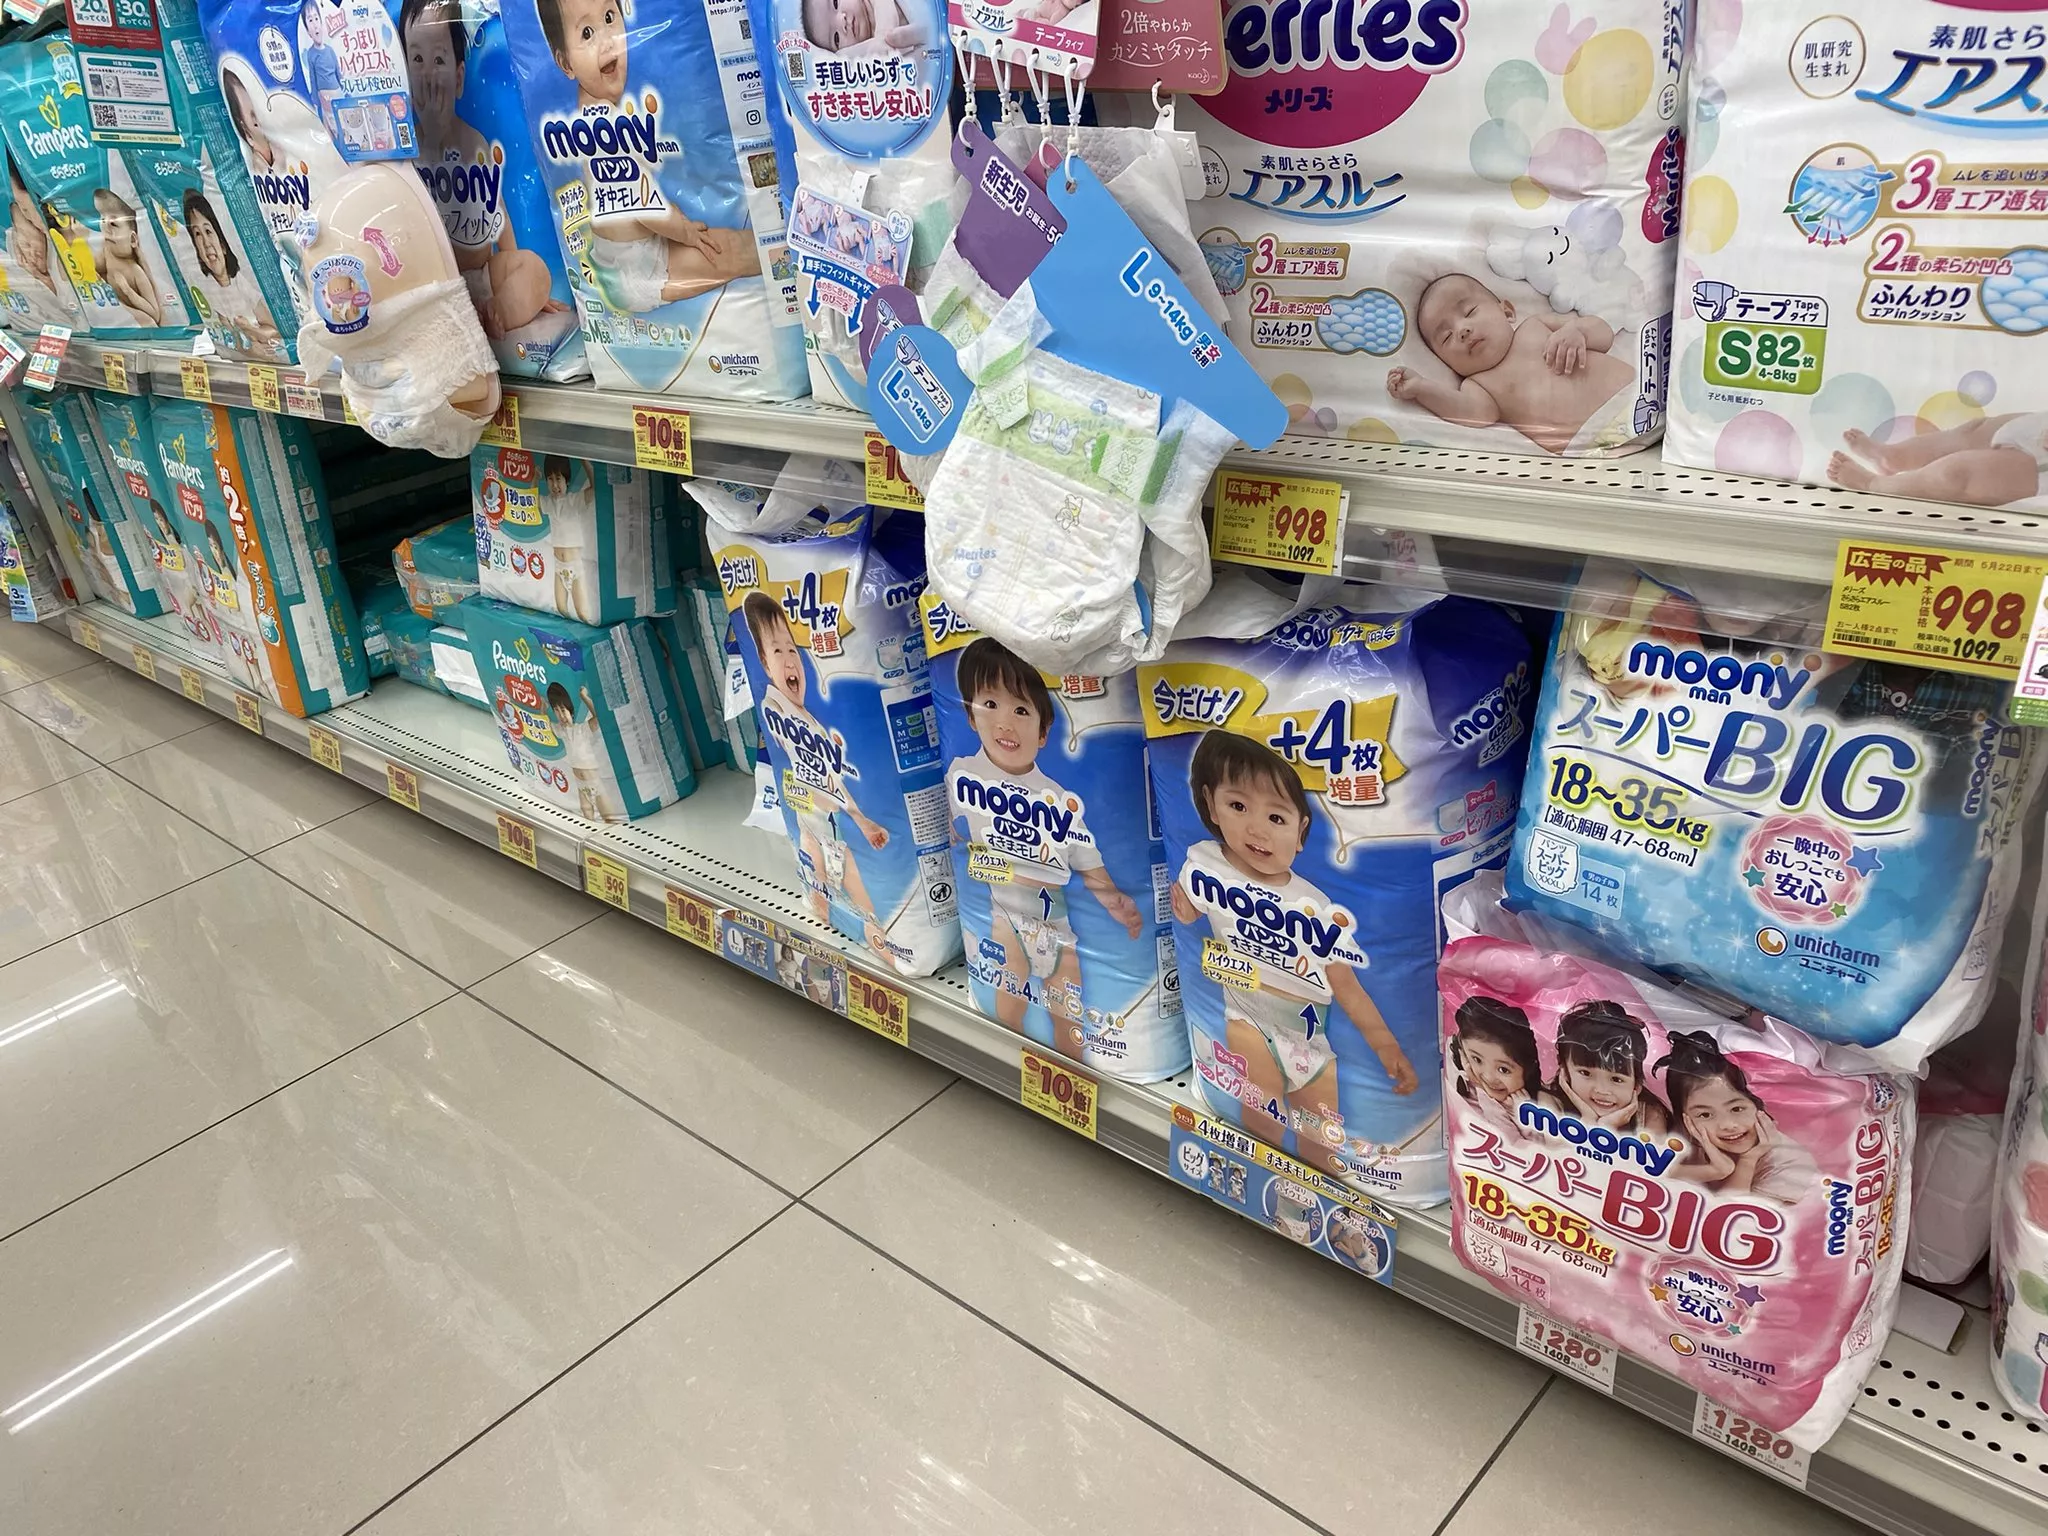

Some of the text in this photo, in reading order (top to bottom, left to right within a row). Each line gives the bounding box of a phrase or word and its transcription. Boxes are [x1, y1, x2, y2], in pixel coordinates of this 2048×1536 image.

[972, 8, 1014, 29] エアスルー
[1121, 8, 1193, 36] 2倍やわらか
[341, 27, 378, 50] すっぽり
[1034, 27, 1085, 52] テープタイプ
[1110, 38, 1214, 63] カシミヤタッチ
[1804, 39, 1853, 61] 肌研究
[340, 48, 391, 75] ハイウエスト
[815, 58, 916, 88] 手直しいらずで
[1805, 61, 1850, 79] 生まれ
[340, 75, 402, 93] ズレモレ不安ゼロへ!
[582, 105, 610, 117] ムーニーマン
[807, 88, 932, 121] すきまモレ安心!
[1264, 86, 1334, 115] メリーズ
[19, 119, 89, 159] Pampers
[544, 113, 658, 164] moony
[656, 140, 680, 154] man
[594, 158, 634, 181] パンツ
[1260, 152, 1359, 172] 素肌さらさら
[253, 174, 310, 211] moony
[559, 186, 586, 205] ゆるうんち
[980, 179, 1007, 209] New Born
[985, 158, 1029, 213] 新生児
[1229, 168, 1404, 210] エアスルー
[563, 202, 585, 220] ポケット
[66, 253, 77, 269] S
[1255, 238, 1340, 276] 3層エア通気
[1283, 246, 1338, 257] ムレを追い出す
[1873, 231, 2013, 276] 2種の柔らか凹凸
[806, 257, 886, 299] 勝手にフィットギャザー
[1121, 249, 1150, 294] L
[816, 281, 859, 306] 体の形に合わせて
[1253, 287, 1333, 316] 2種の柔らか凹凸
[1794, 299, 1820, 312] Tape
[1870, 284, 1972, 309] ふんわり
[1736, 298, 1792, 321] テープ
[1789, 312, 1820, 323] タイプ
[1869, 307, 1966, 322] エアinクッション
[1257, 320, 1313, 339] ふんわり
[1257, 336, 1313, 348] エアinクッション
[1196, 331, 1223, 363] 男女
[720, 353, 760, 367] unicharm
[886, 369, 904, 401] L
[914, 365, 940, 393] テープ
[1758, 368, 1797, 383] 4~8kg
[1707, 391, 1764, 407] 子ども用紙おむつ
[159, 442, 206, 490] Pampers
[503, 459, 530, 479] パンツ
[1227, 480, 1272, 499] 広告の品
[1301, 485, 1336, 498] 5月22日まで
[1275, 505, 1327, 545] 998
[493, 548, 506, 567] 30
[1287, 544, 1315, 562] 1097
[1850, 550, 1928, 575] 広告の品
[720, 556, 758, 595] 今だけ!
[1953, 558, 2043, 577] 期間 5月22日まで
[783, 572, 839, 631] +4枚
[1843, 585, 1867, 595] メリーズ
[1917, 585, 1934, 628] 本体価格
[1932, 585, 2026, 639] 998
[1836, 620, 1899, 634] お一人様2点まで
[1917, 632, 1951, 644] 税率10%
[811, 630, 839, 654] 増量
[1953, 637, 2000, 661] 1097
[491, 638, 547, 685] Pampers
[1628, 641, 1813, 711] moony
[511, 687, 537, 707] パンツ
[1154, 679, 1241, 724] 今だけ!
[1689, 686, 1732, 706] man
[764, 706, 858, 777] moony man
[1269, 699, 1379, 775] +4枚
[521, 763, 535, 775] 30
[1329, 775, 1380, 802] 増量
[956, 776, 1074, 843] moony
[1066, 829, 1091, 844] man
[1550, 757, 1710, 849] 18~35kg
[996, 818, 1036, 842] パンツ
[1543, 803, 1698, 867] 【適応胴囲 47~68cm】
[1536, 847, 1570, 866] スーパー
[1541, 838, 1568, 854] パンツ
[1776, 836, 1841, 862] 一晩中の
[971, 852, 1009, 869] ハイウエスト
[1537, 858, 1566, 879] ビッグ
[1764, 849, 1845, 882] おしっこでも
[605, 876, 624, 896] 599
[1586, 871, 1618, 889] 男の子用
[1774, 872, 1828, 907] 安心
[1245, 883, 1282, 903] ムーニーマン
[1190, 869, 1364, 964] moony man
[731, 929, 738, 945] L
[1205, 939, 1228, 954] すっぽり
[1243, 923, 1291, 953] パンツ
[1207, 951, 1253, 974] ハイウエスト
[1793, 934, 1881, 969] unicharm
[978, 961, 1003, 988] ビッグ
[1799, 957, 1867, 985] ユニ・チャーム
[1085, 1031, 1127, 1050] unicharm
[1040, 1065, 1092, 1113] 10倍!
[1215, 1064, 1243, 1098] ビッグ
[1244, 1092, 1288, 1126] 38+4枚
[1197, 1119, 1257, 1159] 4枚増量!
[1519, 1102, 1676, 1177] moony
[1182, 1145, 1206, 1167] ビッグ
[1576, 1145, 1614, 1166] man
[1183, 1163, 1203, 1179] サイズ
[1349, 1161, 1403, 1181] unicharm
[1275, 1183, 1317, 1208] ハイウエスト
[1463, 1123, 1780, 1268] スーパーBIG
[1464, 1173, 1615, 1265] 18~35kg
[1827, 1180, 1854, 1257] moony
[1846, 1206, 1854, 1226] man
[1468, 1209, 1610, 1278] 【適応胴囲 47~68cm】
[1673, 1268, 1729, 1293] 一晩中の
[1664, 1276, 1735, 1311] おしっこでも
[1676, 1294, 1725, 1325] 安心
[1533, 1322, 1602, 1368] 1280
[1543, 1345, 1572, 1366] 1408
[1700, 1341, 1776, 1376] unicharm
[1707, 1362, 1768, 1387] ユニ・チャーム
[1712, 1409, 1794, 1459] 1280
[1724, 1434, 1757, 1456] 1408
